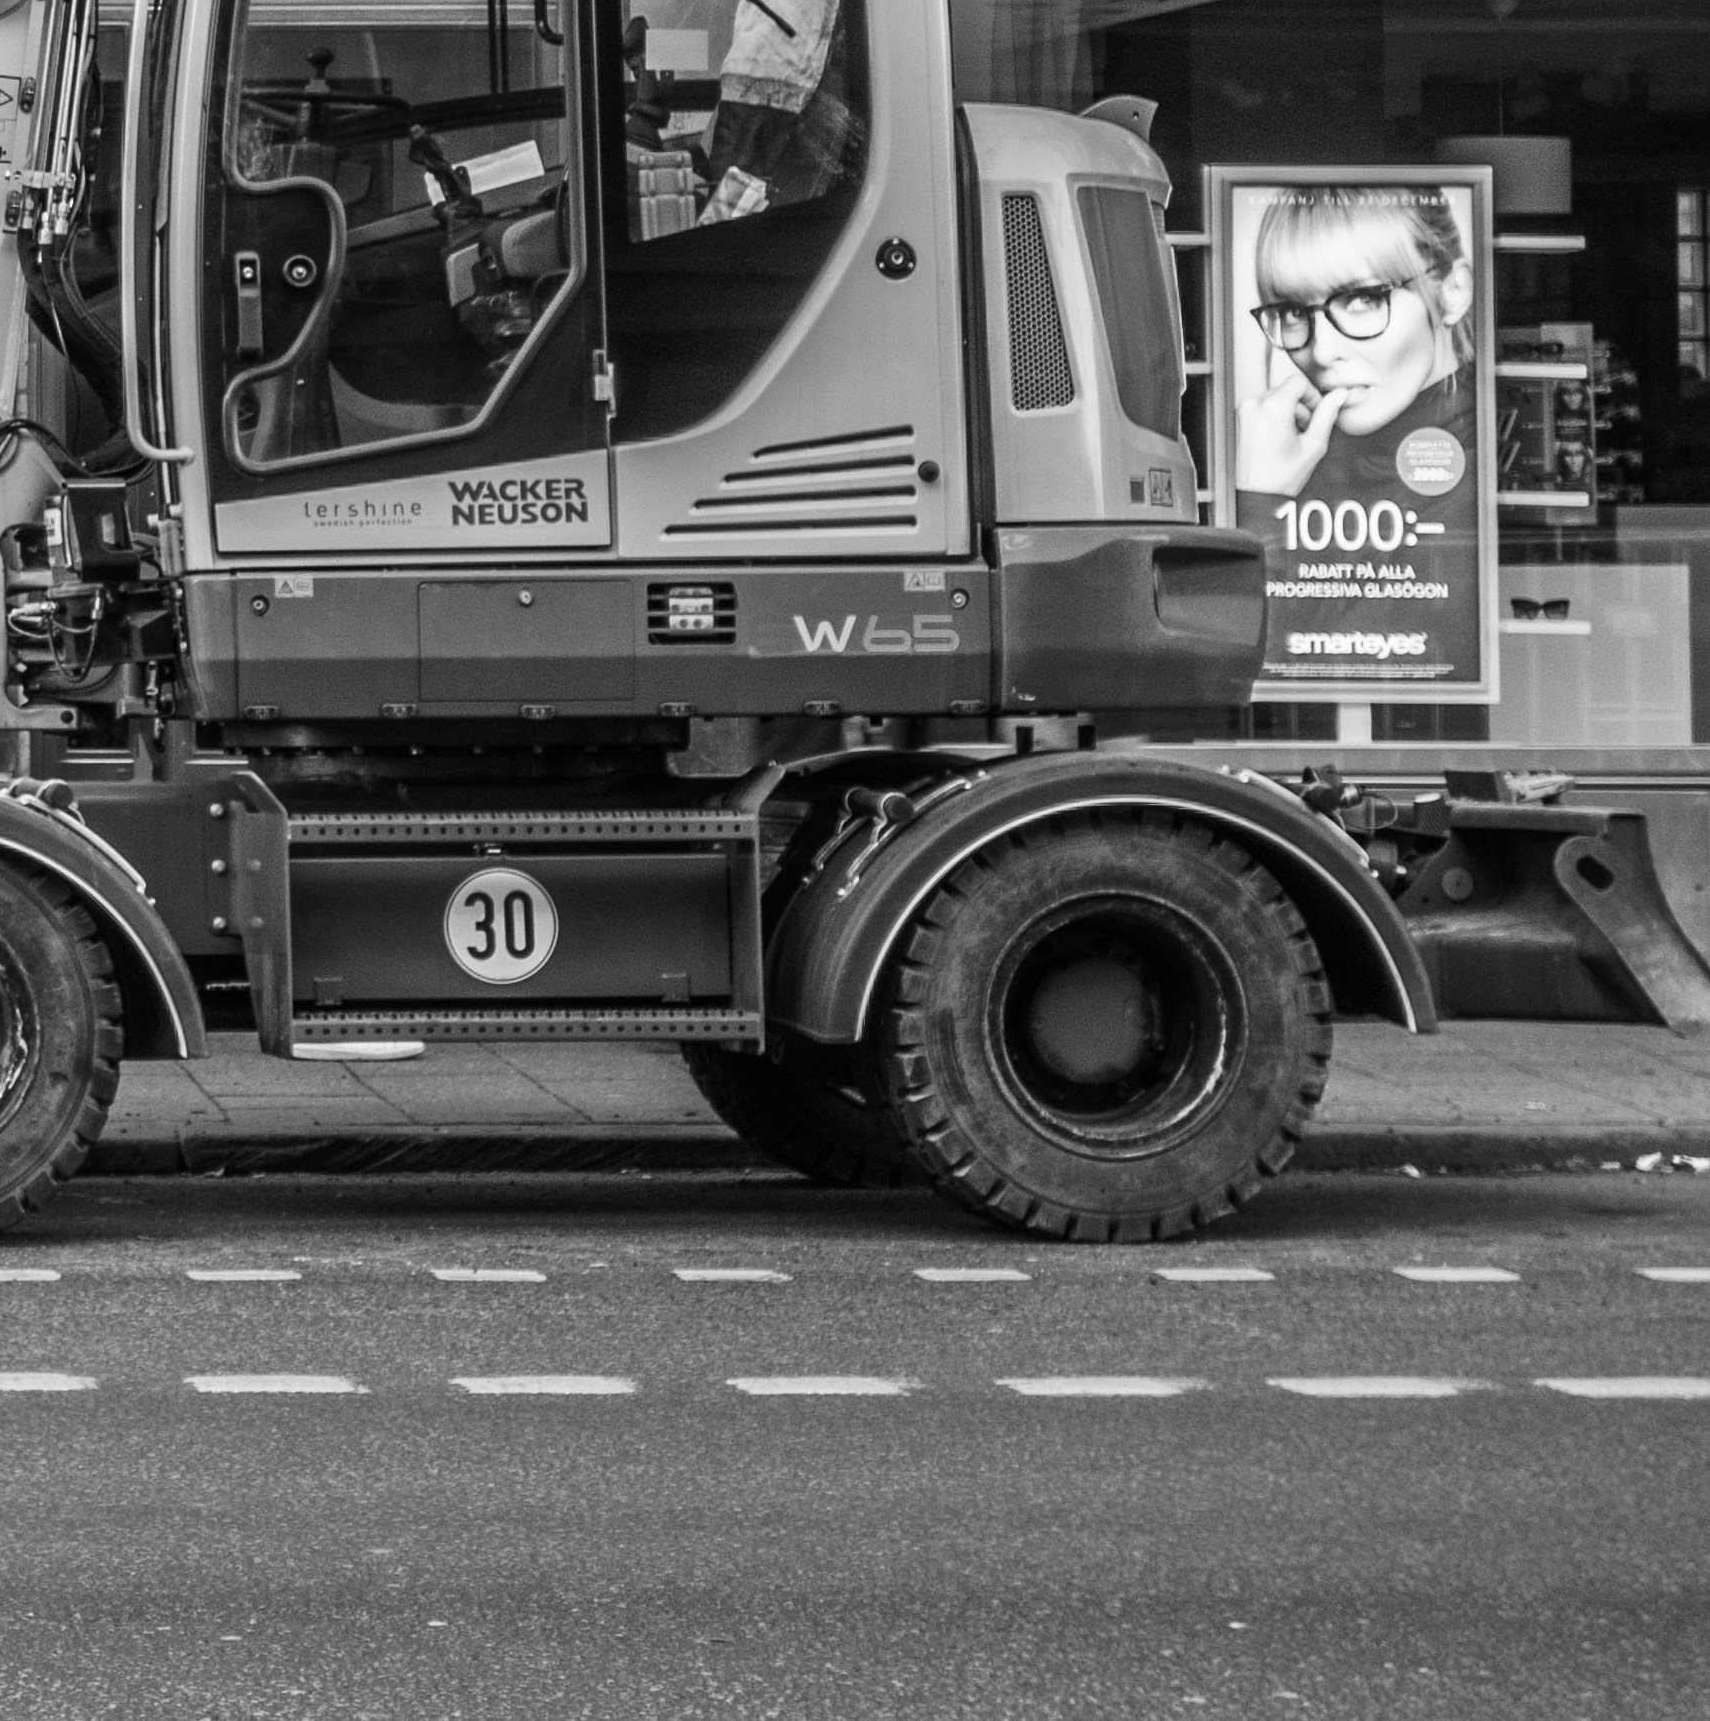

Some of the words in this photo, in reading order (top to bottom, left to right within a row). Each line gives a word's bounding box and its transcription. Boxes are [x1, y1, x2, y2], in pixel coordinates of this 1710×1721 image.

[448, 479, 587, 503] WACKER
[303, 499, 423, 518] tershine
[451, 501, 589, 527] NEUSON
[313, 519, 355, 527] swedish
[359, 517, 413, 527] perfection
[1274, 499, 1446, 552] 1000:-
[1298, 563, 1354, 579] RABATT
[1356, 560, 1376, 579] PÅ
[1379, 564, 1416, 579] ALLA
[1265, 581, 1363, 598] PROGRESSIVA
[1364, 580, 1449, 599] GLASÖGON
[1285, 631, 1428, 659] smarteyes
[464, 890, 535, 960] 30
